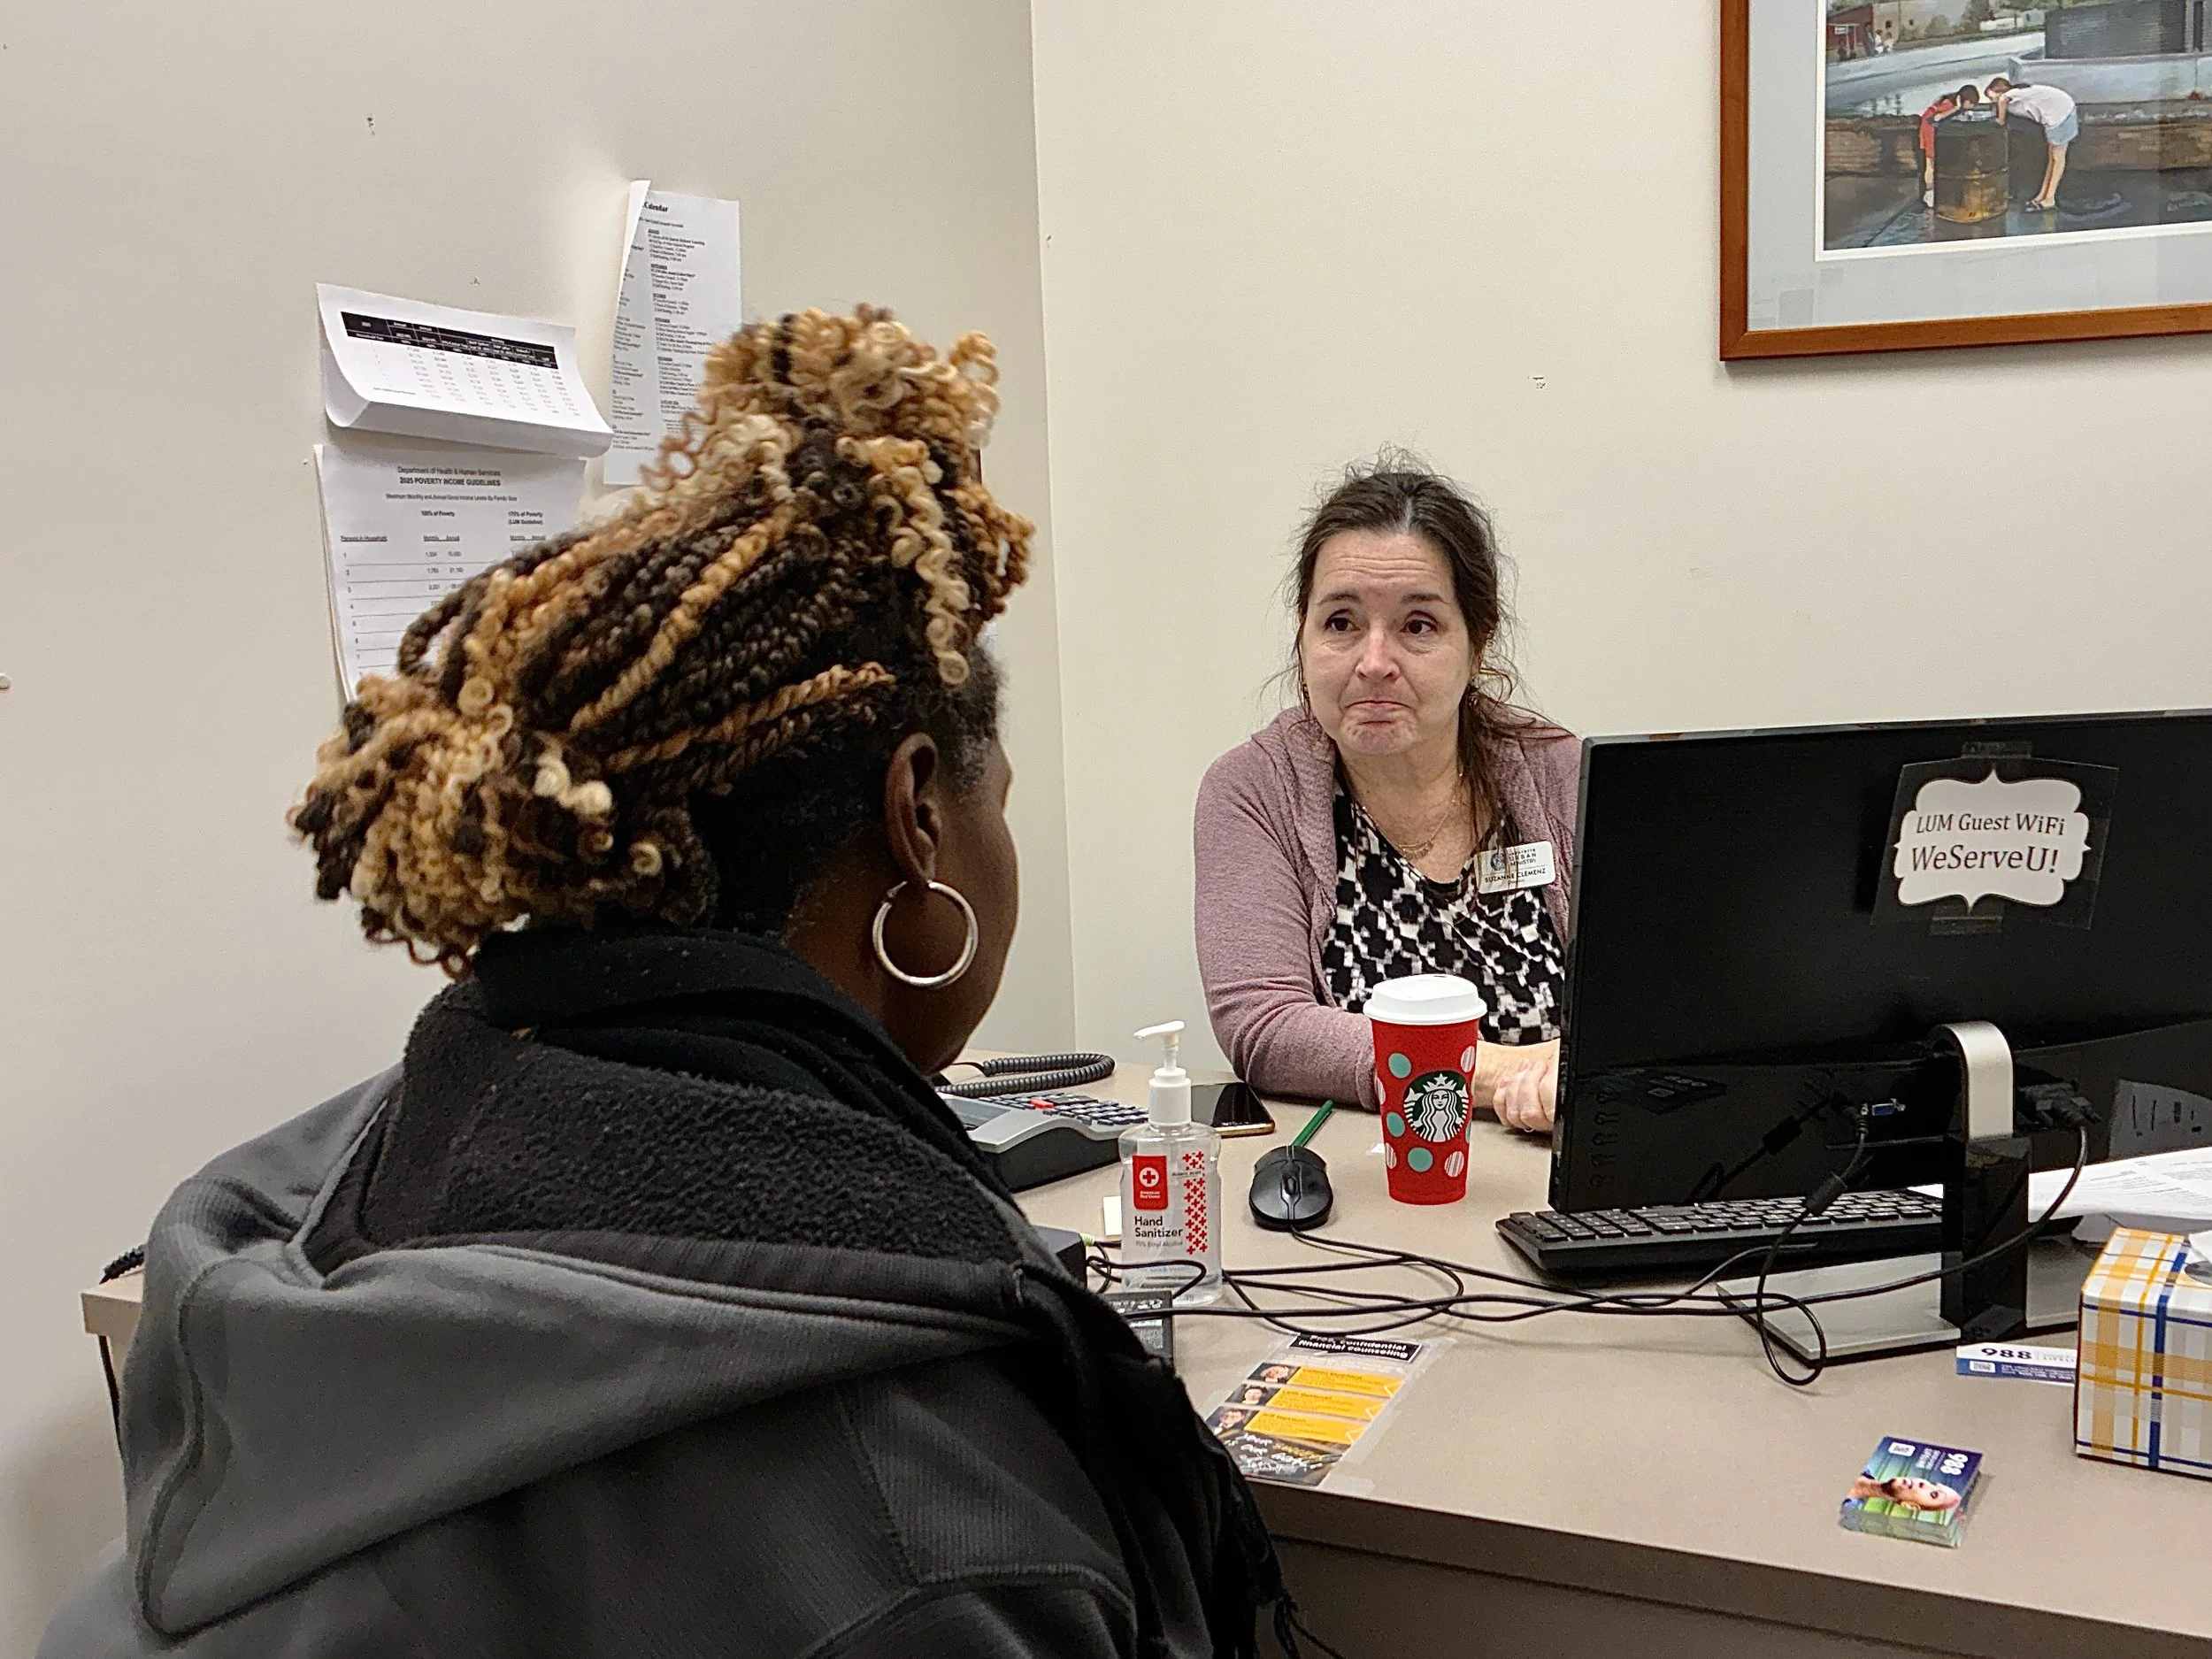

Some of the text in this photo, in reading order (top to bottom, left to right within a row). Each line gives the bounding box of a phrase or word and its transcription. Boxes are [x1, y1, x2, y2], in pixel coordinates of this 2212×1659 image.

[1916, 812, 2066, 836] LUM Guest WiFi
[1509, 852, 1537, 862] URBAN
[1911, 844, 2059, 873] WeServeU!
[1485, 872, 1515, 883] SUZANNE
[1517, 867, 1547, 878] CLEMENZ
[1134, 1216, 1163, 1226] Hand
[1135, 1227, 1184, 1238] Sanitizer
[1298, 1340, 1409, 1359] financial counseling
[1981, 1348, 2032, 1360] 988
[1939, 1453, 1969, 1476] 988
